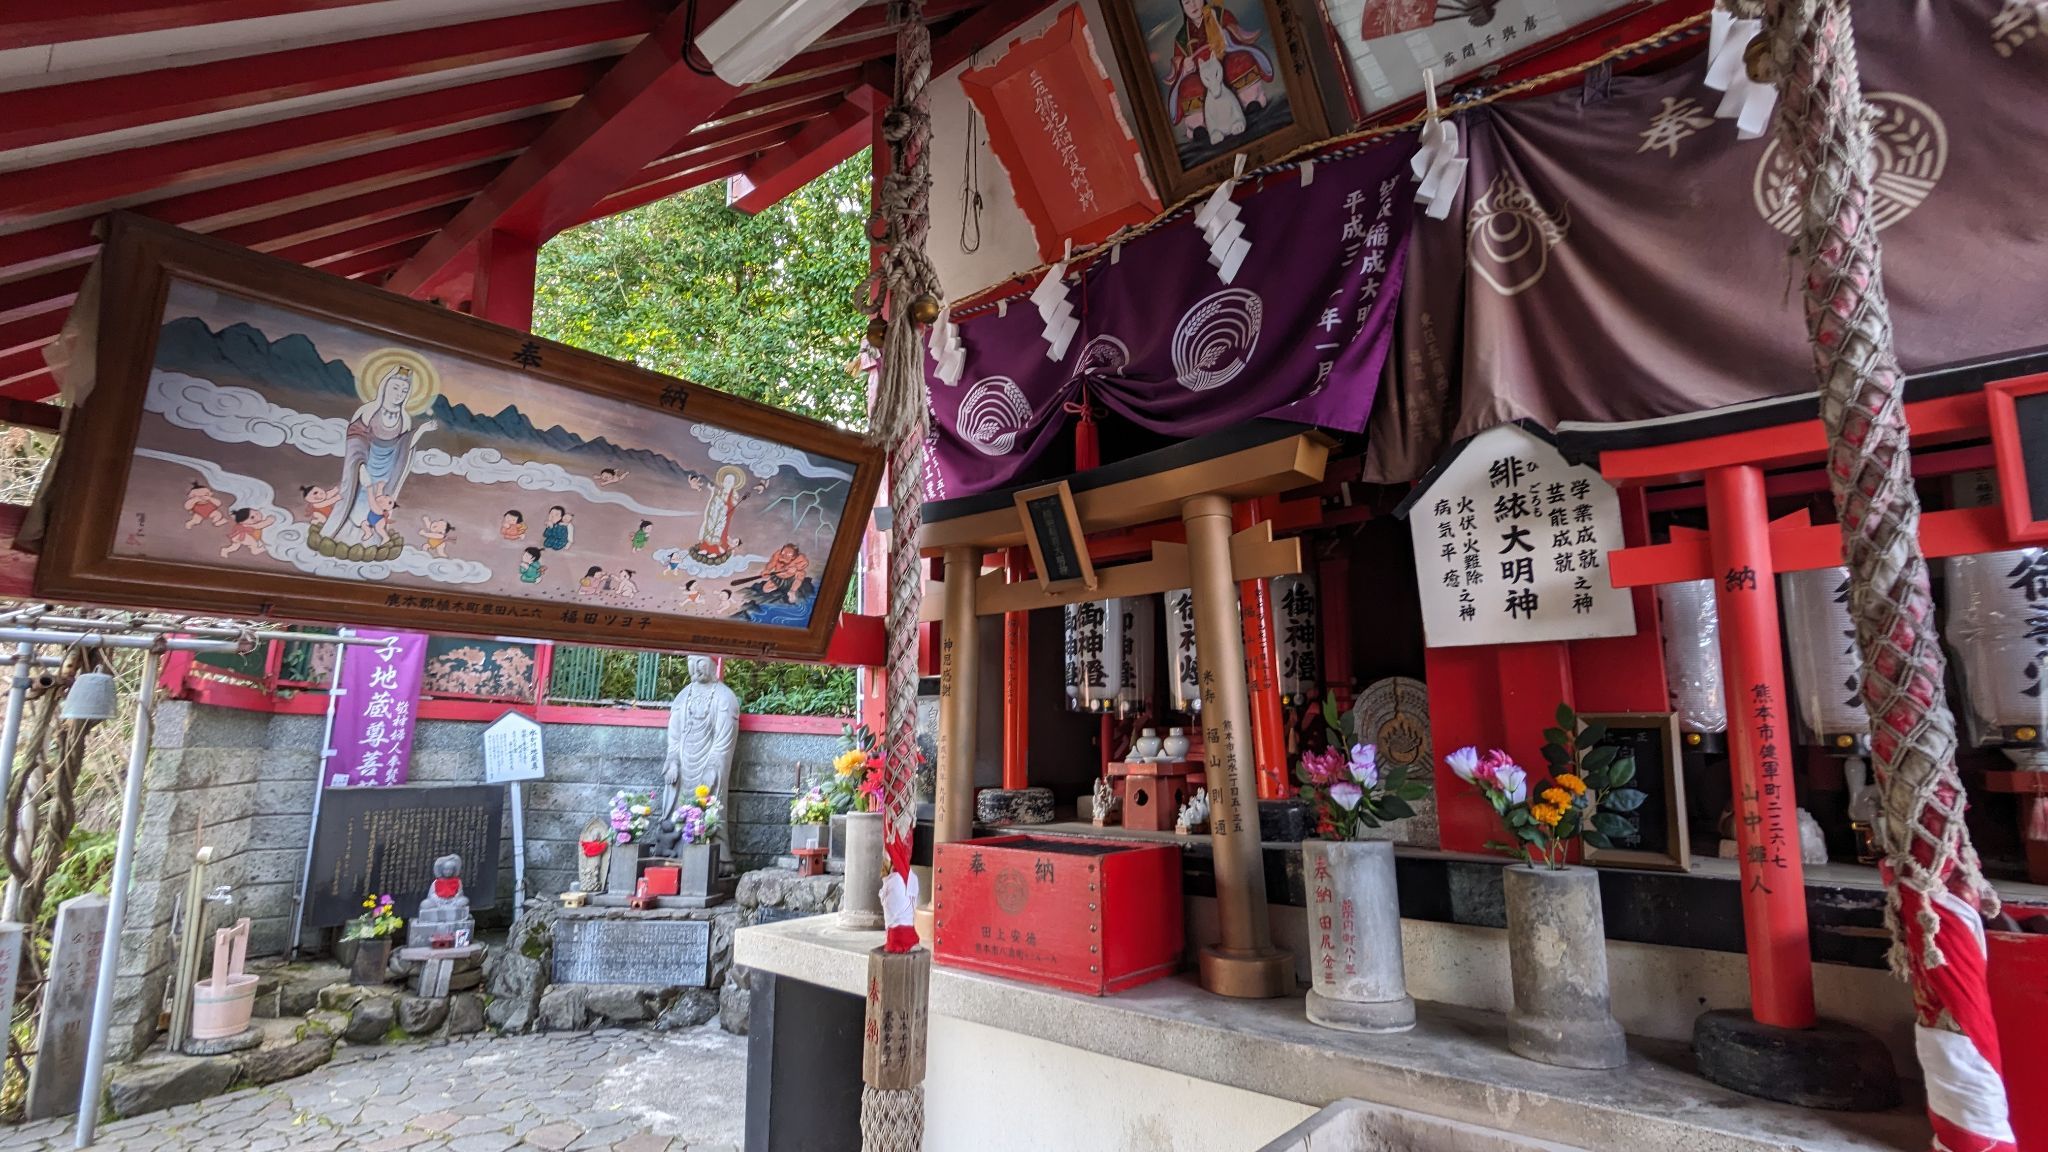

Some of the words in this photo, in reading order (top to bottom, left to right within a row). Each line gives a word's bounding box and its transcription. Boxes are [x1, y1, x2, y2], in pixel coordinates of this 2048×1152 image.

[1637, 97, 1714, 158] 奉
[1433, 498, 1461, 589] 病気平癒
[1546, 482, 1576, 574] 芸能成就
[1725, 566, 1757, 593] 納
[1076, 602, 1110, 687] 御神燈
[1281, 583, 1317, 683] 御神燈
[355, 636, 403, 786] 子地蔵尊菩
[1206, 727, 1228, 836] 福山則通
[1314, 855, 1333, 904] 奉納
[866, 976, 880, 1045] 奉納
